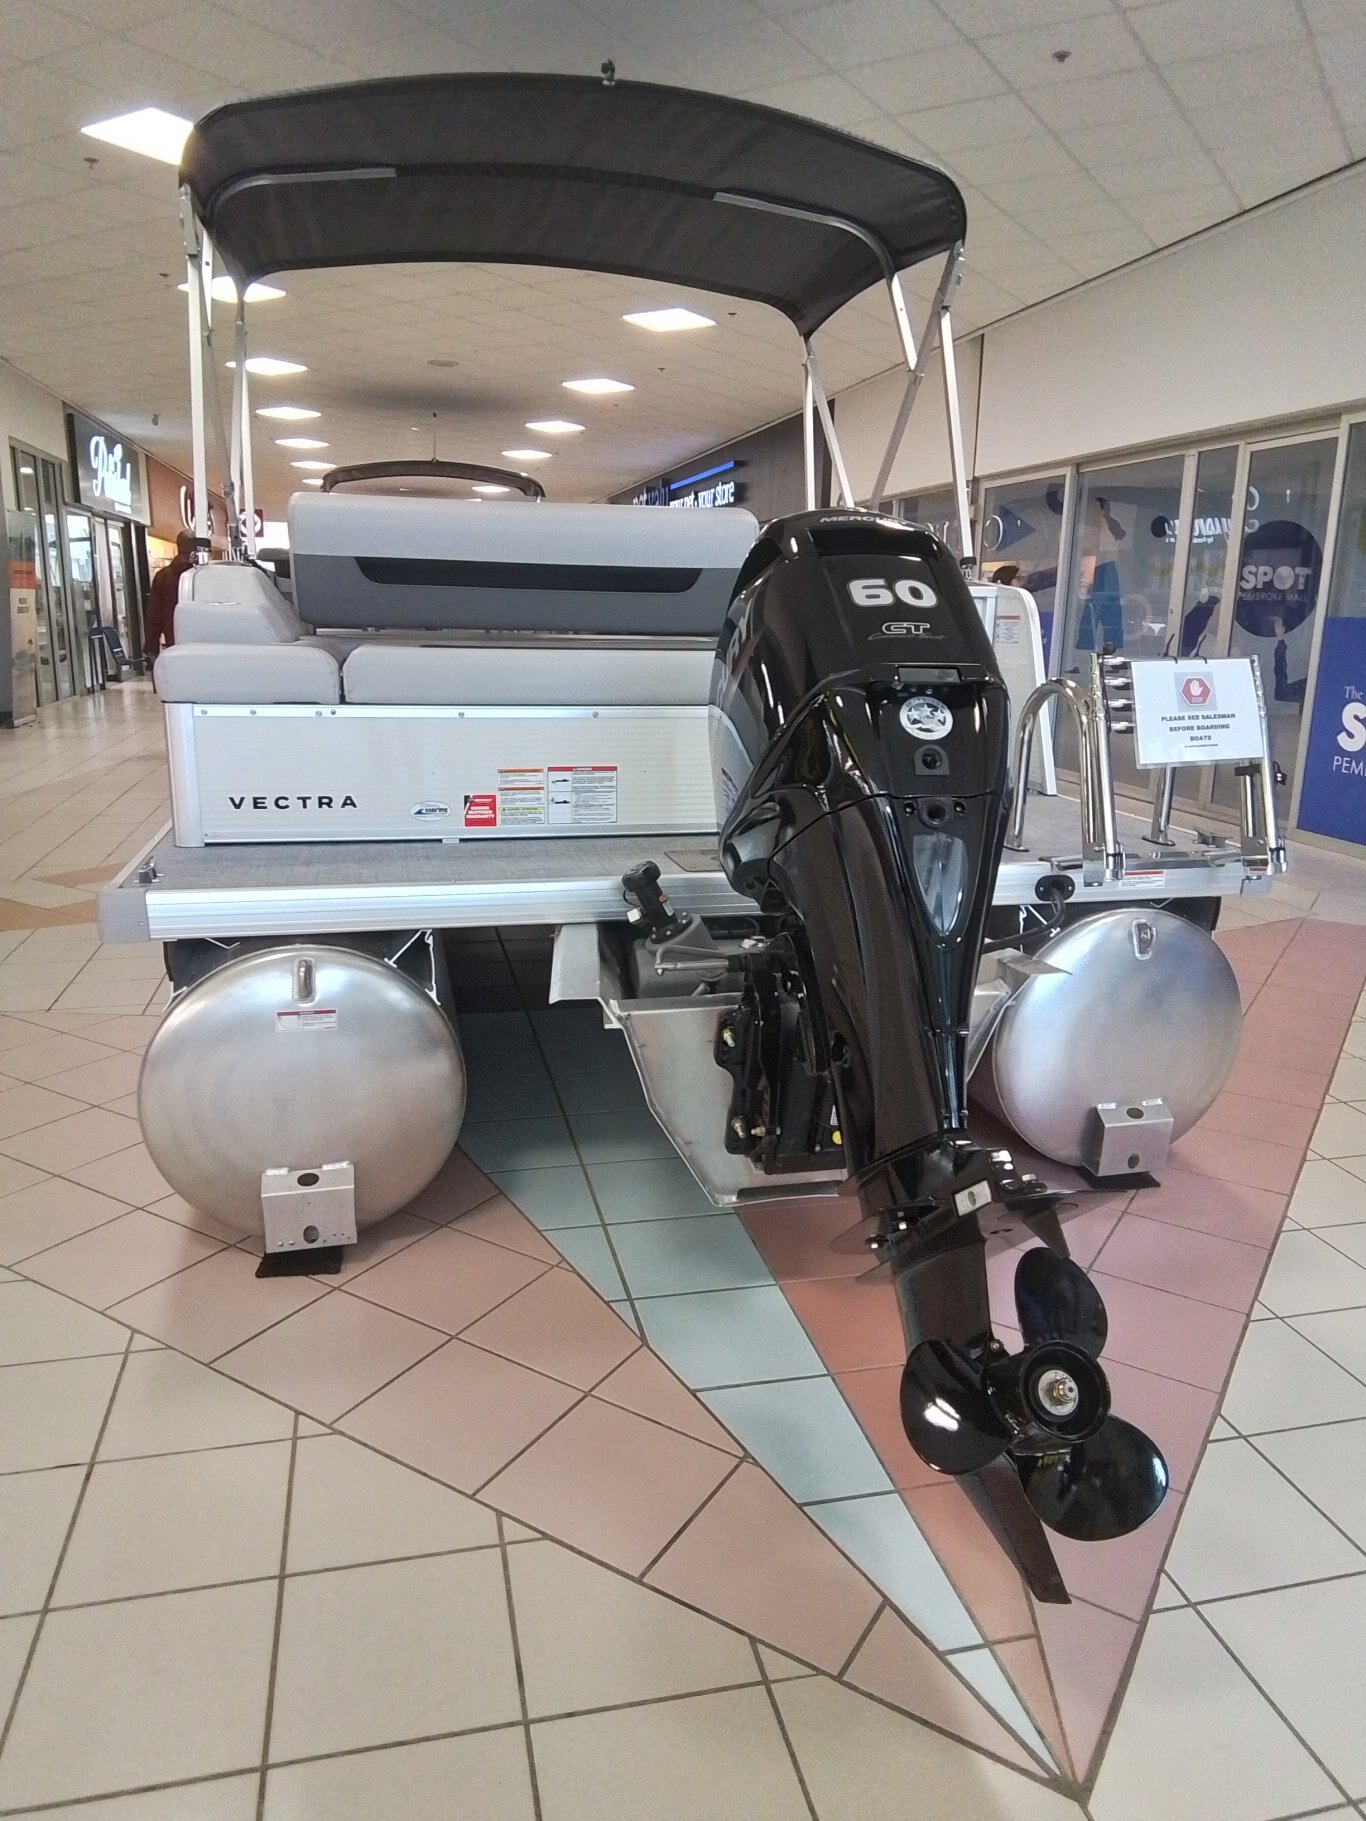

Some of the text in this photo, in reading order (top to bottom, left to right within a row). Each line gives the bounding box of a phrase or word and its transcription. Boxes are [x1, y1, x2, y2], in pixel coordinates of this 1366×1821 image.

[698, 488, 714, 508] your
[715, 481, 735, 506] store
[1240, 564, 1312, 590] SPOT
[847, 578, 938, 607] 60
[882, 621, 930, 634] GT
[1344, 685, 1364, 700] The
[1196, 723, 1230, 731] BOARDING
[1337, 702, 1366, 752] S
[1332, 755, 1366, 777] PEM
[228, 795, 358, 810] VECTRA
